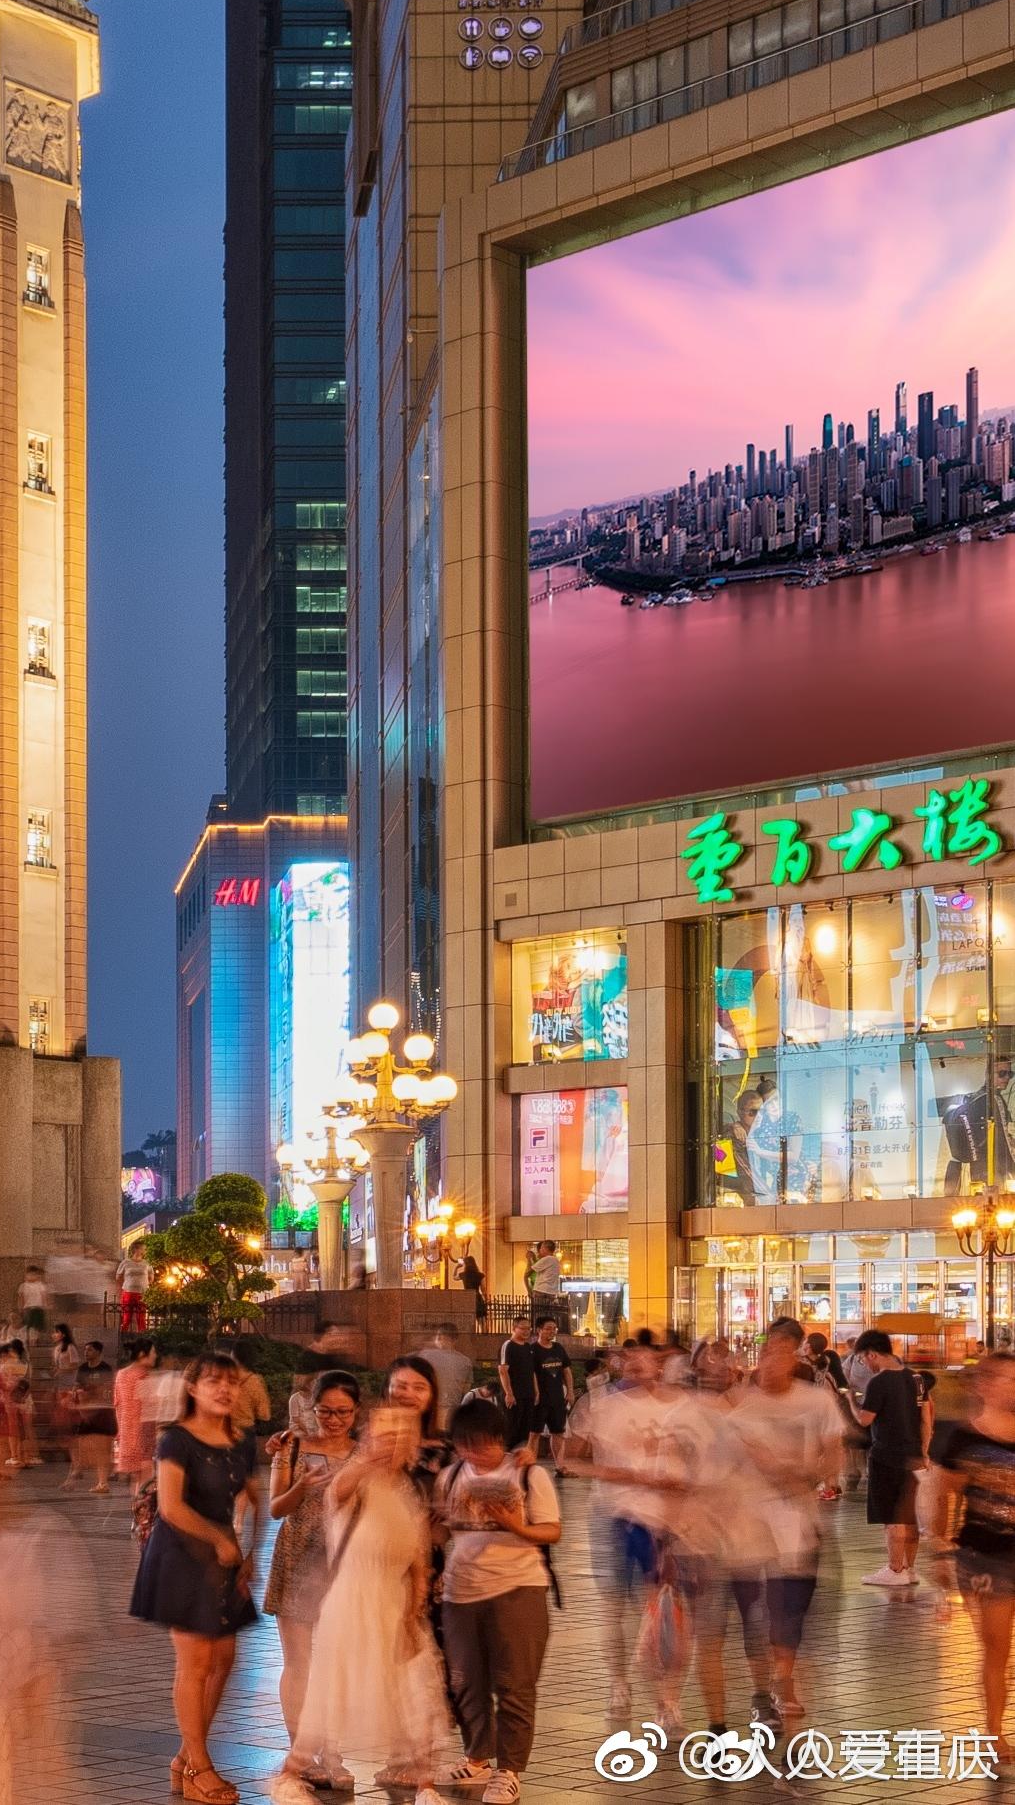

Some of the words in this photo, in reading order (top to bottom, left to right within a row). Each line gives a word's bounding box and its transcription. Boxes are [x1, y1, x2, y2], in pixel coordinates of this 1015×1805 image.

[680, 777, 1003, 904] 重百大楼
[215, 878, 260, 907] H&M
